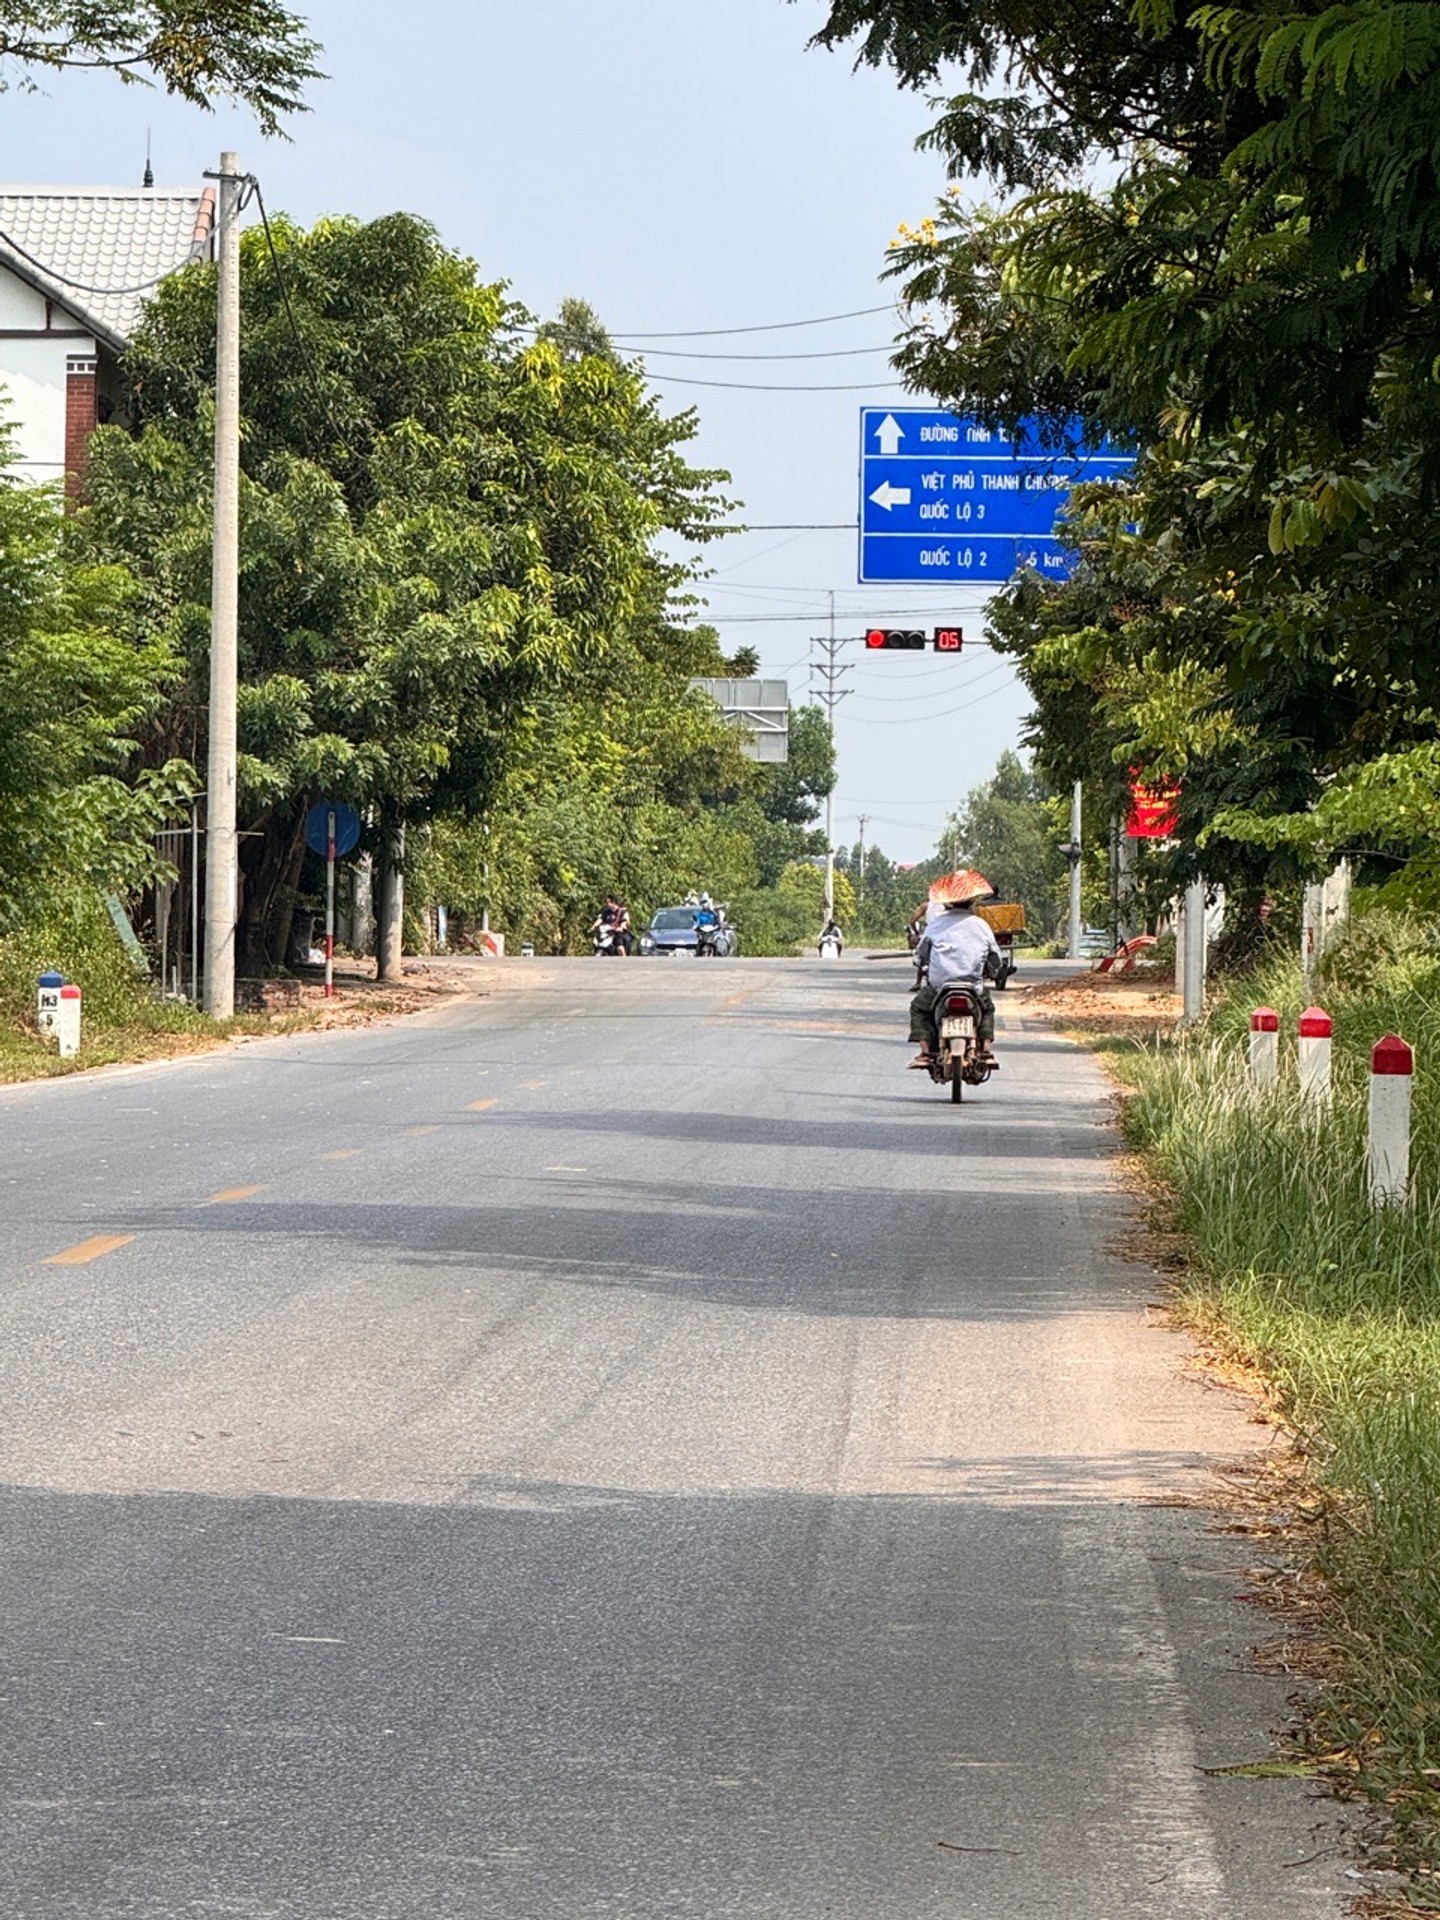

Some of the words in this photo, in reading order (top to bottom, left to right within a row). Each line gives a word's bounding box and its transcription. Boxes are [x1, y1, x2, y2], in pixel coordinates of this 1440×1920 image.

[920, 423, 958, 442] ĐƯỜNG
[921, 471, 946, 492] VIỆT
[952, 470, 975, 490] PHỦ
[981, 474, 1020, 490] THANH
[919, 498, 949, 519] QUỐC
[956, 501, 971, 522] LỘ
[977, 504, 985, 519] 3
[919, 545, 950, 566] QUỐC
[957, 547, 972, 569] LỘ
[979, 551, 987, 566] 2
[938, 631, 959, 648] 05
[41, 994, 58, 1007] H3
[46, 1014, 53, 1026] 5
